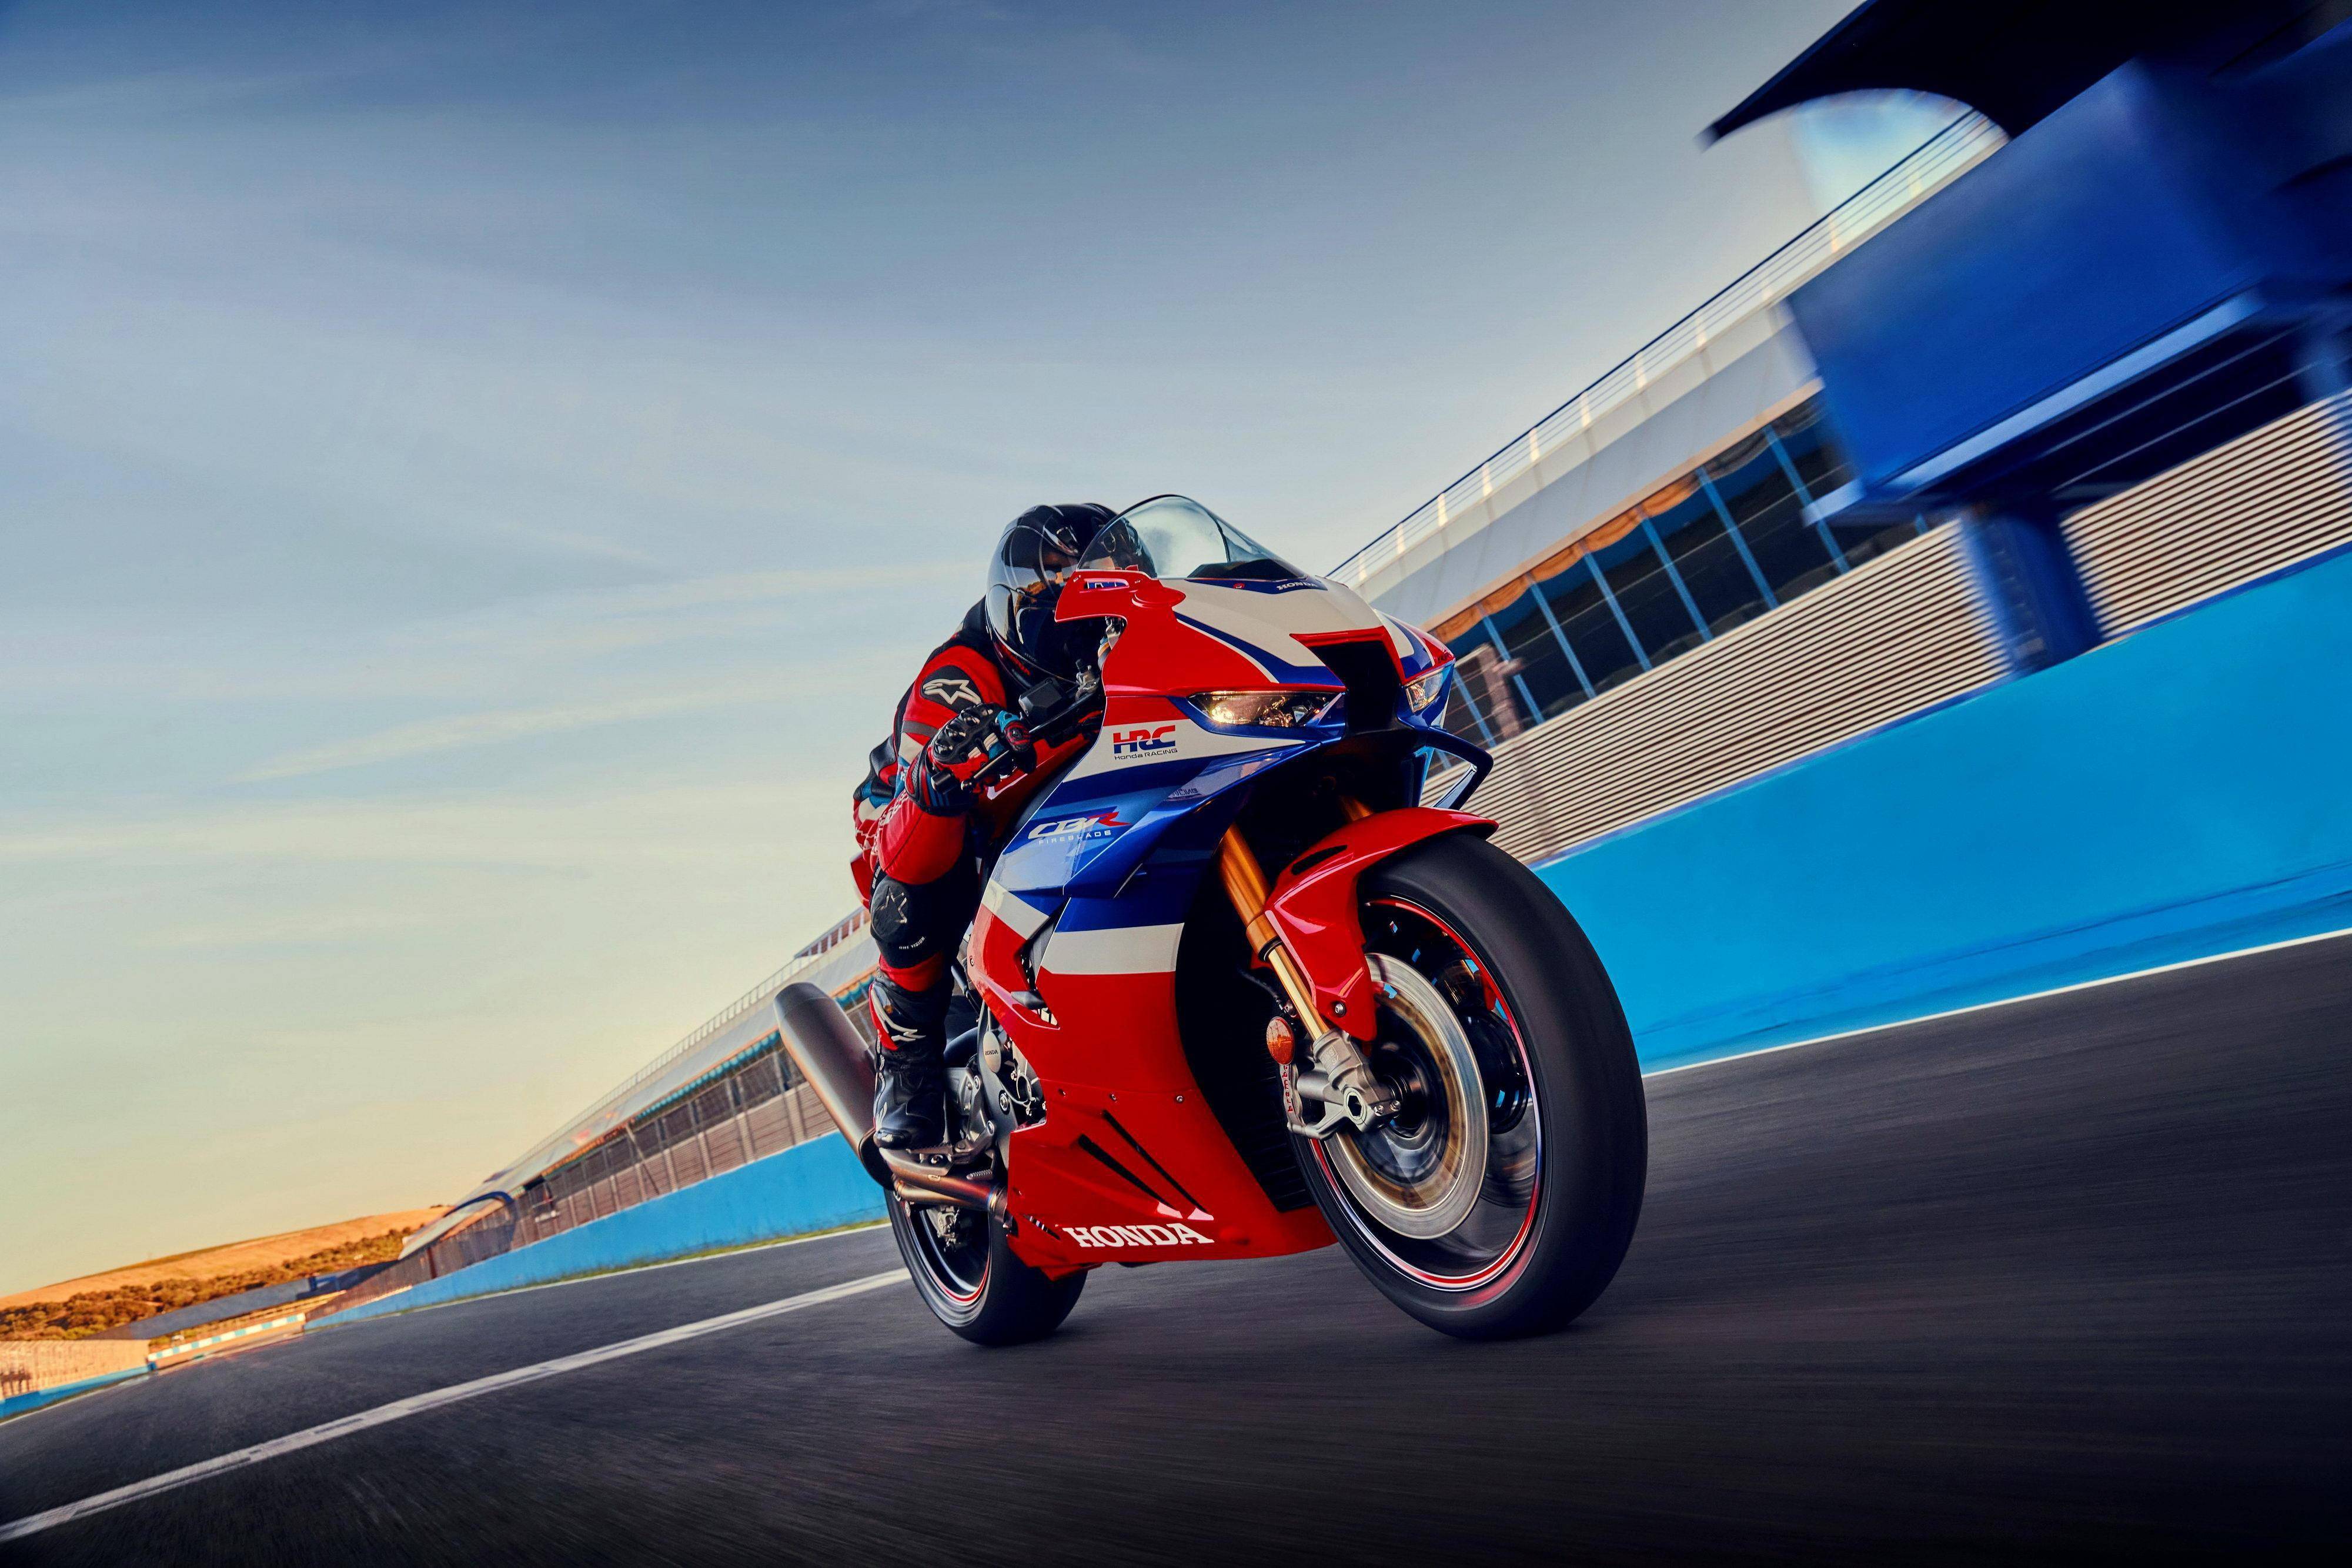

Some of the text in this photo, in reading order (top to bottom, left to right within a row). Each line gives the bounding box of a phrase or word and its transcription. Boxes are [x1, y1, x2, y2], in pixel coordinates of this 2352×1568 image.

[1276, 581, 1318, 590] HONDA
[1113, 725, 1175, 754] HRC
[1144, 748, 1178, 757] RACING
[1028, 811, 1132, 840] CBR
[1038, 830, 1112, 845] FIREBLADE
[911, 936, 925, 948] VISION
[1062, 1222, 1215, 1247] HONDA
